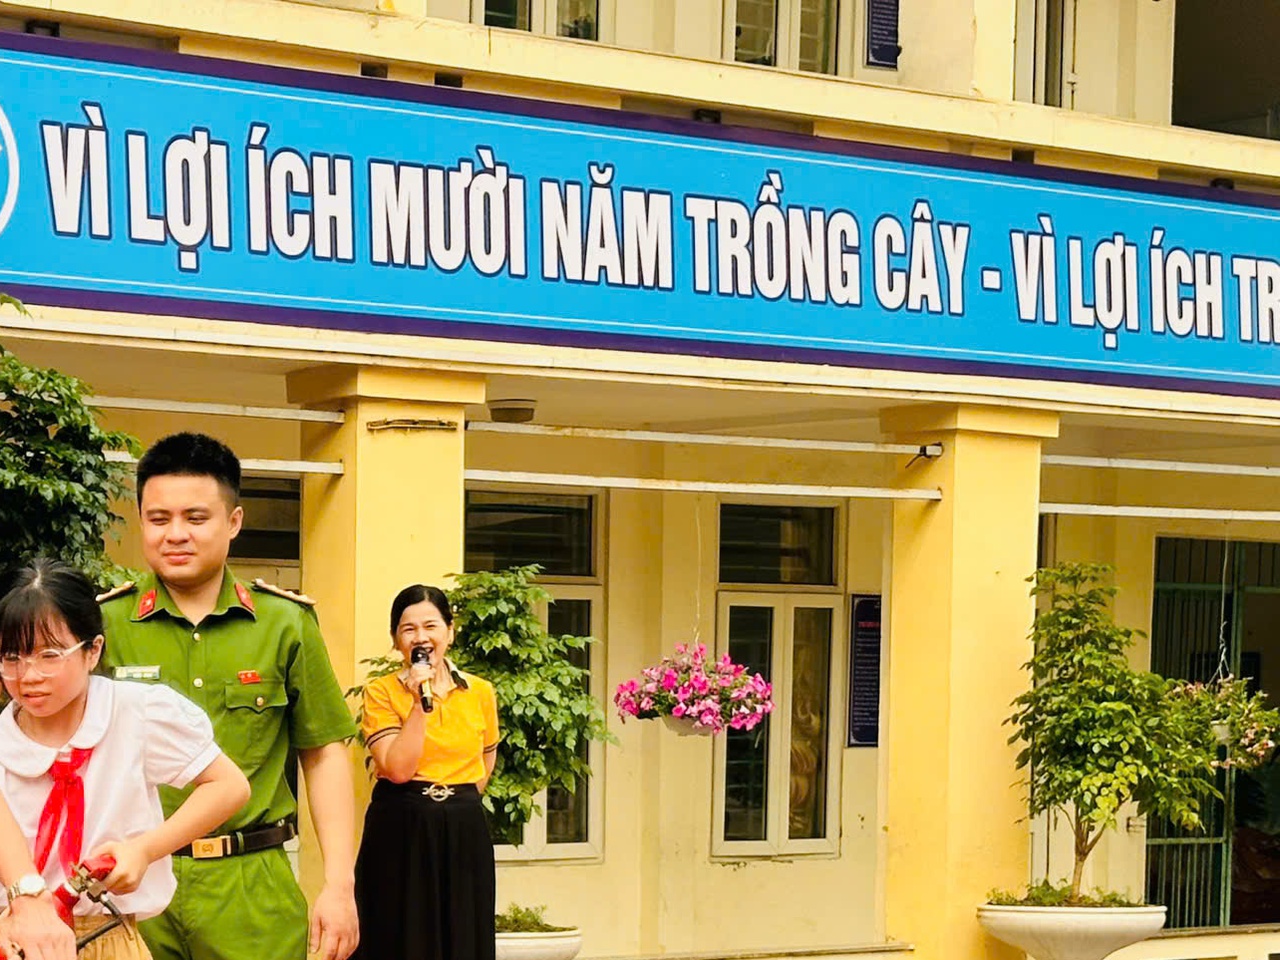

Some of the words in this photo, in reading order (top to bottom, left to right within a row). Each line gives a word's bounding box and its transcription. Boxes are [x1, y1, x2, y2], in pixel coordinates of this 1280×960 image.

[40, 101, 112, 239] VÌ
[125, 126, 232, 273] LỢI
[245, 121, 355, 263] ÍCH
[369, 145, 528, 279] MƯỜI
[540, 161, 675, 293] NĂM
[683, 170, 863, 307] TRỒNG
[872, 198, 972, 316] CÂY
[981, 266, 1003, 292] -
[1010, 213, 1058, 325] VÌ
[1067, 231, 1141, 350] LỢI
[1148, 226, 1225, 340] ÍCH
